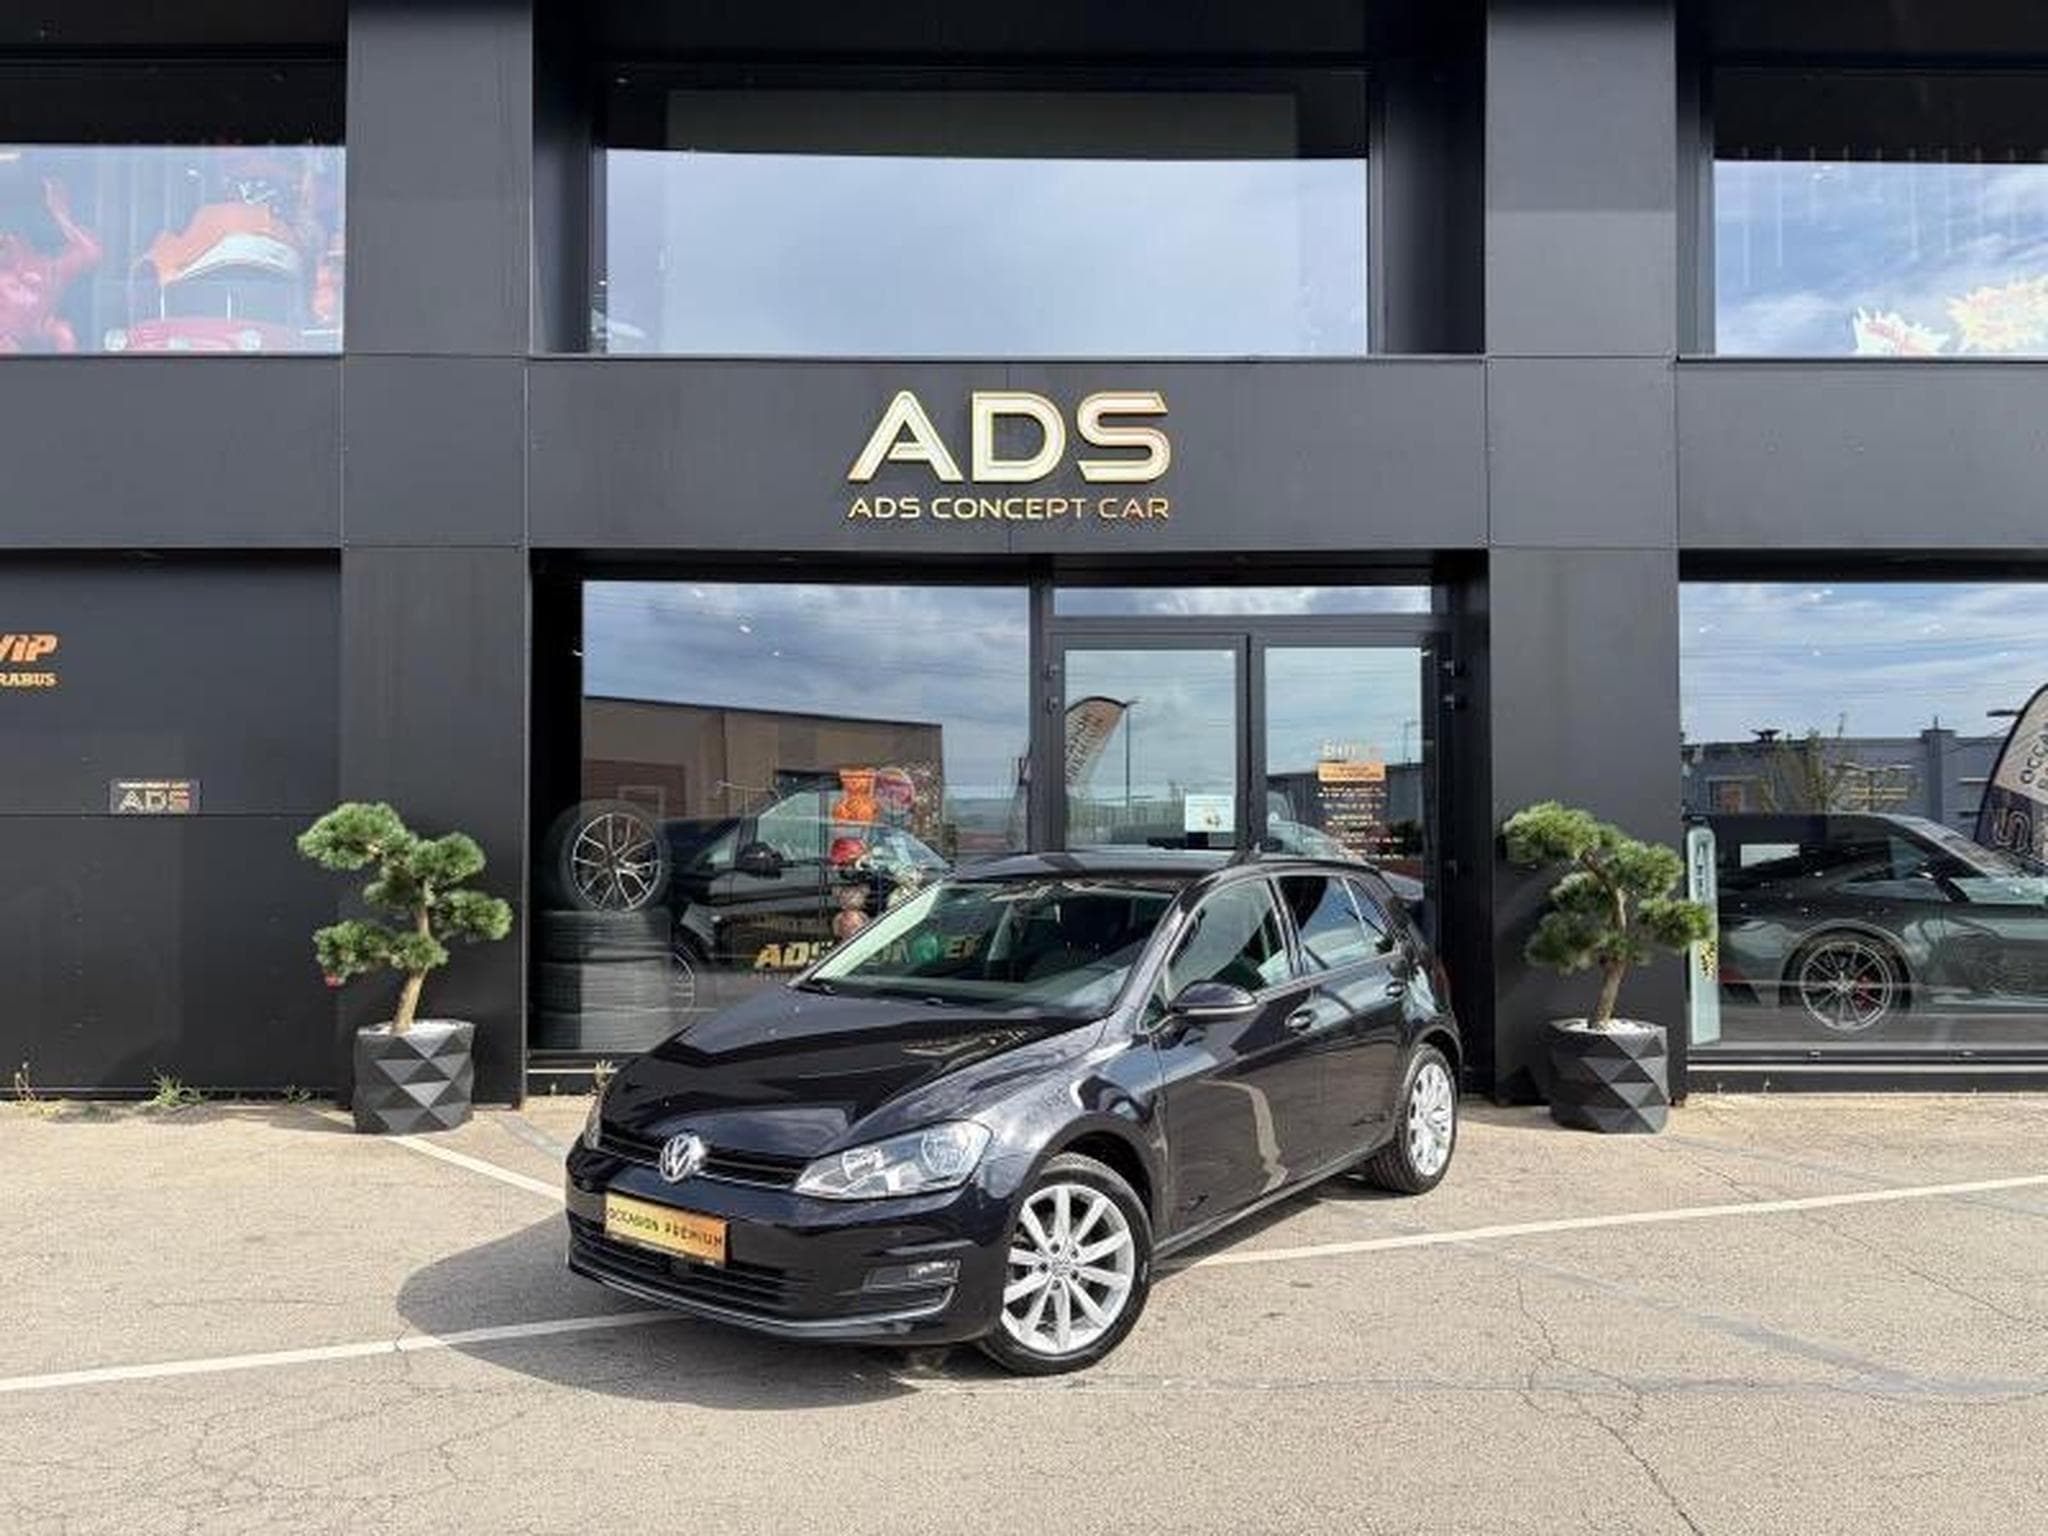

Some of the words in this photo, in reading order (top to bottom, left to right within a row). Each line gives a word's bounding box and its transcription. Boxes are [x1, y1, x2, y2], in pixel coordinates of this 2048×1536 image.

[848, 390, 1172, 482] ADS
[848, 498, 921, 519] ADS
[931, 498, 1087, 519] CONCEPT
[1098, 498, 1170, 519] CAR
[119, 790, 190, 813] ADS
